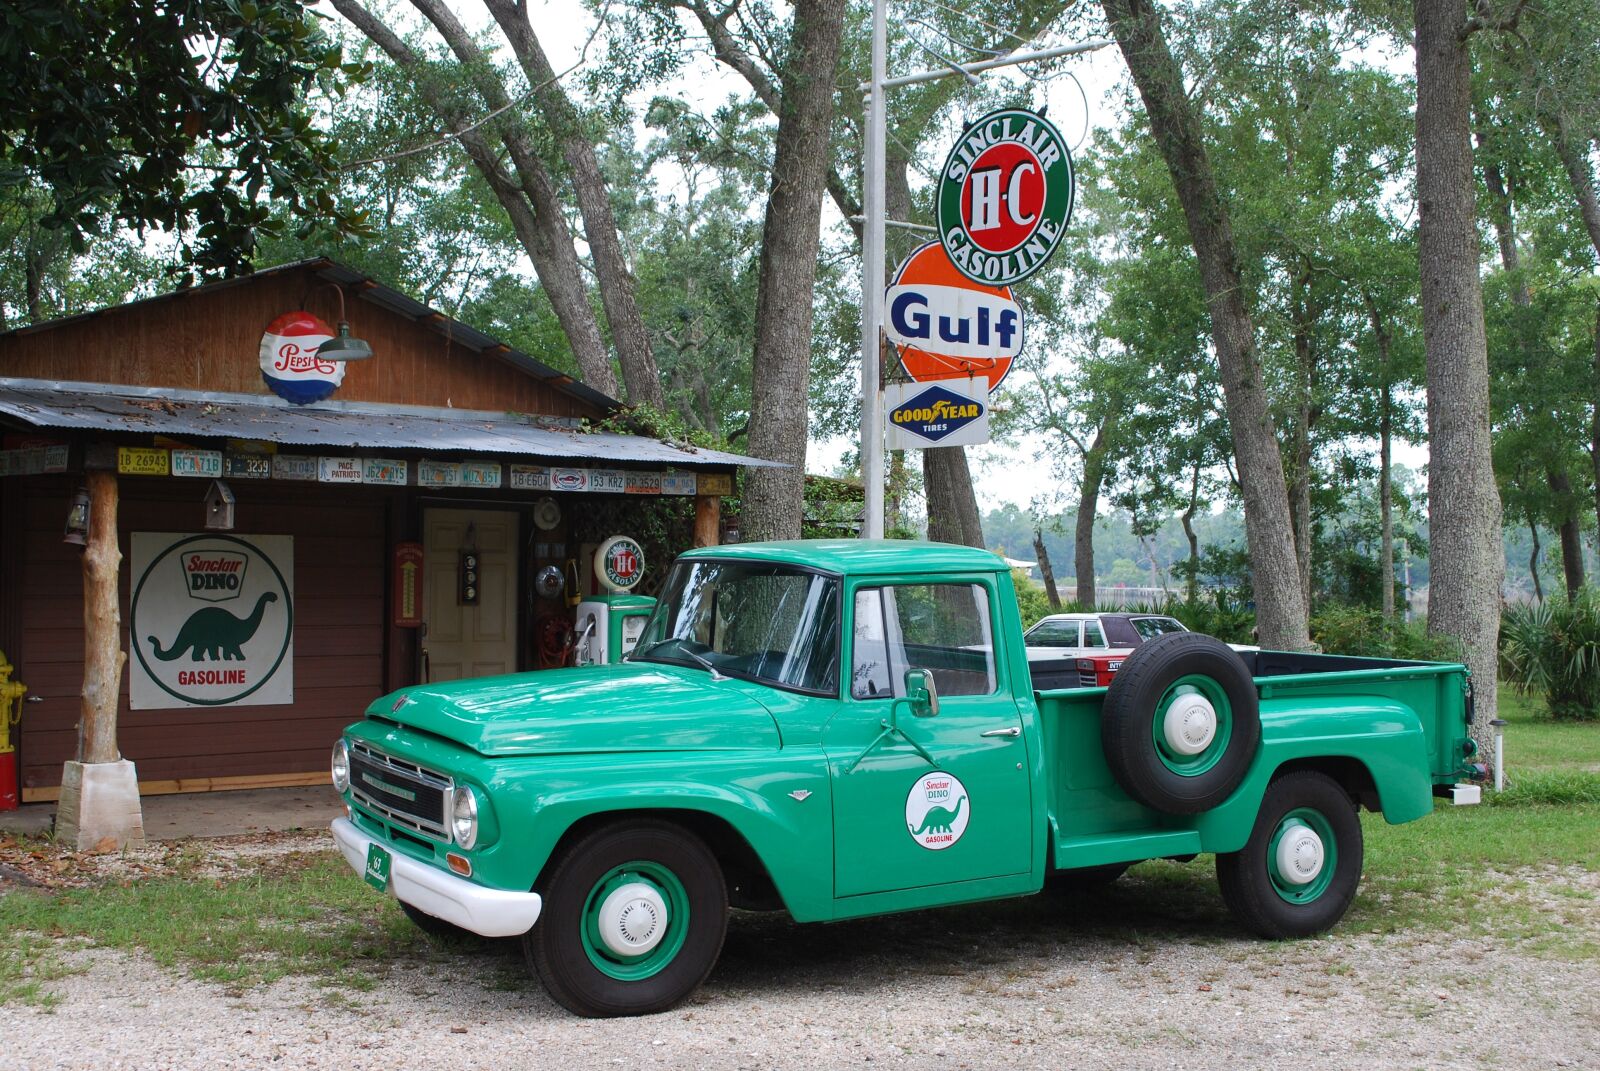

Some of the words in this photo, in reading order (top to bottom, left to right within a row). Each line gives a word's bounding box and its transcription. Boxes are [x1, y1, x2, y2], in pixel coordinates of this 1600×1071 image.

[948, 117, 1061, 183] SINCLAIR
[946, 218, 1060, 280] GASOLINE
[891, 292, 1017, 348] Gulf
[923, 424, 947, 432] TIRES
[136, 455, 167, 468] 26943
[175, 456, 195, 471] RFA
[247, 460, 268, 473] 3259
[338, 462, 353, 470] PACE
[608, 476, 623, 488] KRZ
[188, 555, 242, 572] Sinclair
[191, 573, 239, 590] DINO
[178, 669, 246, 685] GASOLINE
[926, 781, 949, 790] Sinclair
[928, 790, 948, 798] DINO
[926, 835, 952, 843] GASOLINE
